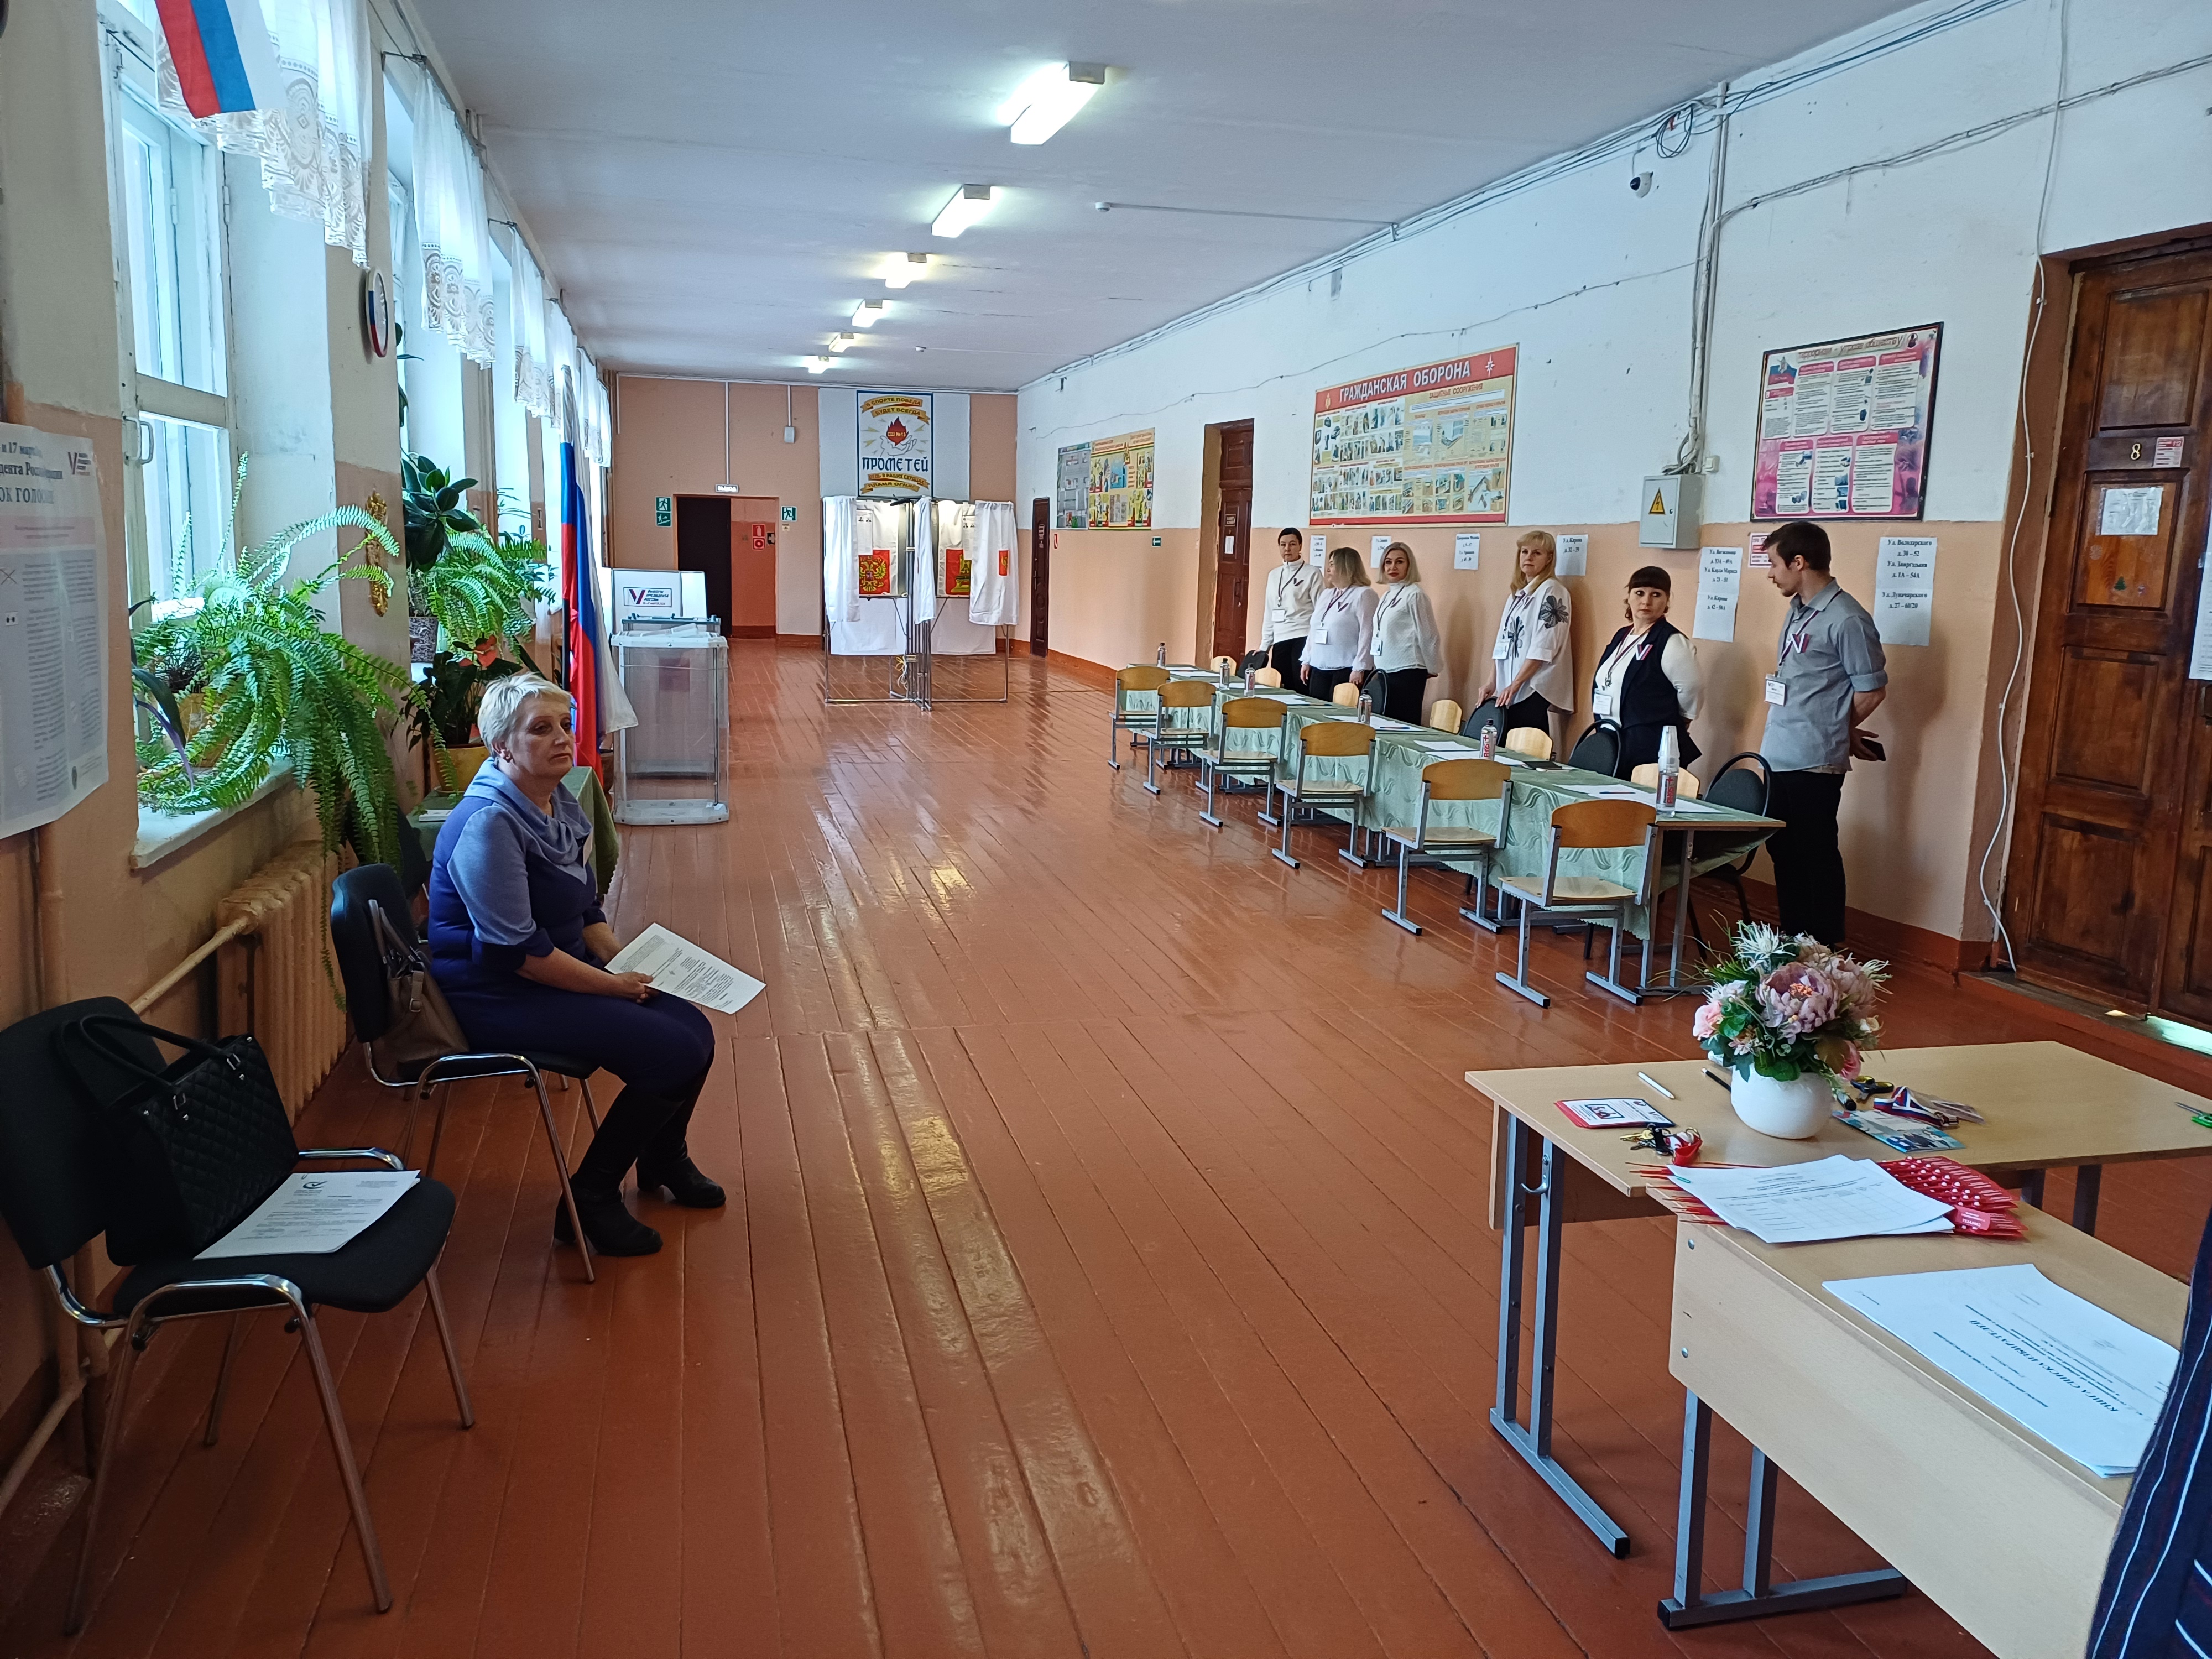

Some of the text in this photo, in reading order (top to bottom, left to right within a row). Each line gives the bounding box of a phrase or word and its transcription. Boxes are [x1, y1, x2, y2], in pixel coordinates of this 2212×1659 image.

[1339, 361, 1471, 403] ГРАЖДАНСКАЯ ОБОРОНА
[896, 408, 920, 416] ВСЕГДА
[9, 442, 18, 453] 17
[2130, 443, 2141, 460] 8
[862, 456, 928, 472] ПРОМЕТЕЙ
[1969, 1320, 2119, 1412] КНИГА СПИСКА ИЗБИРАТЕЛЕЙ
